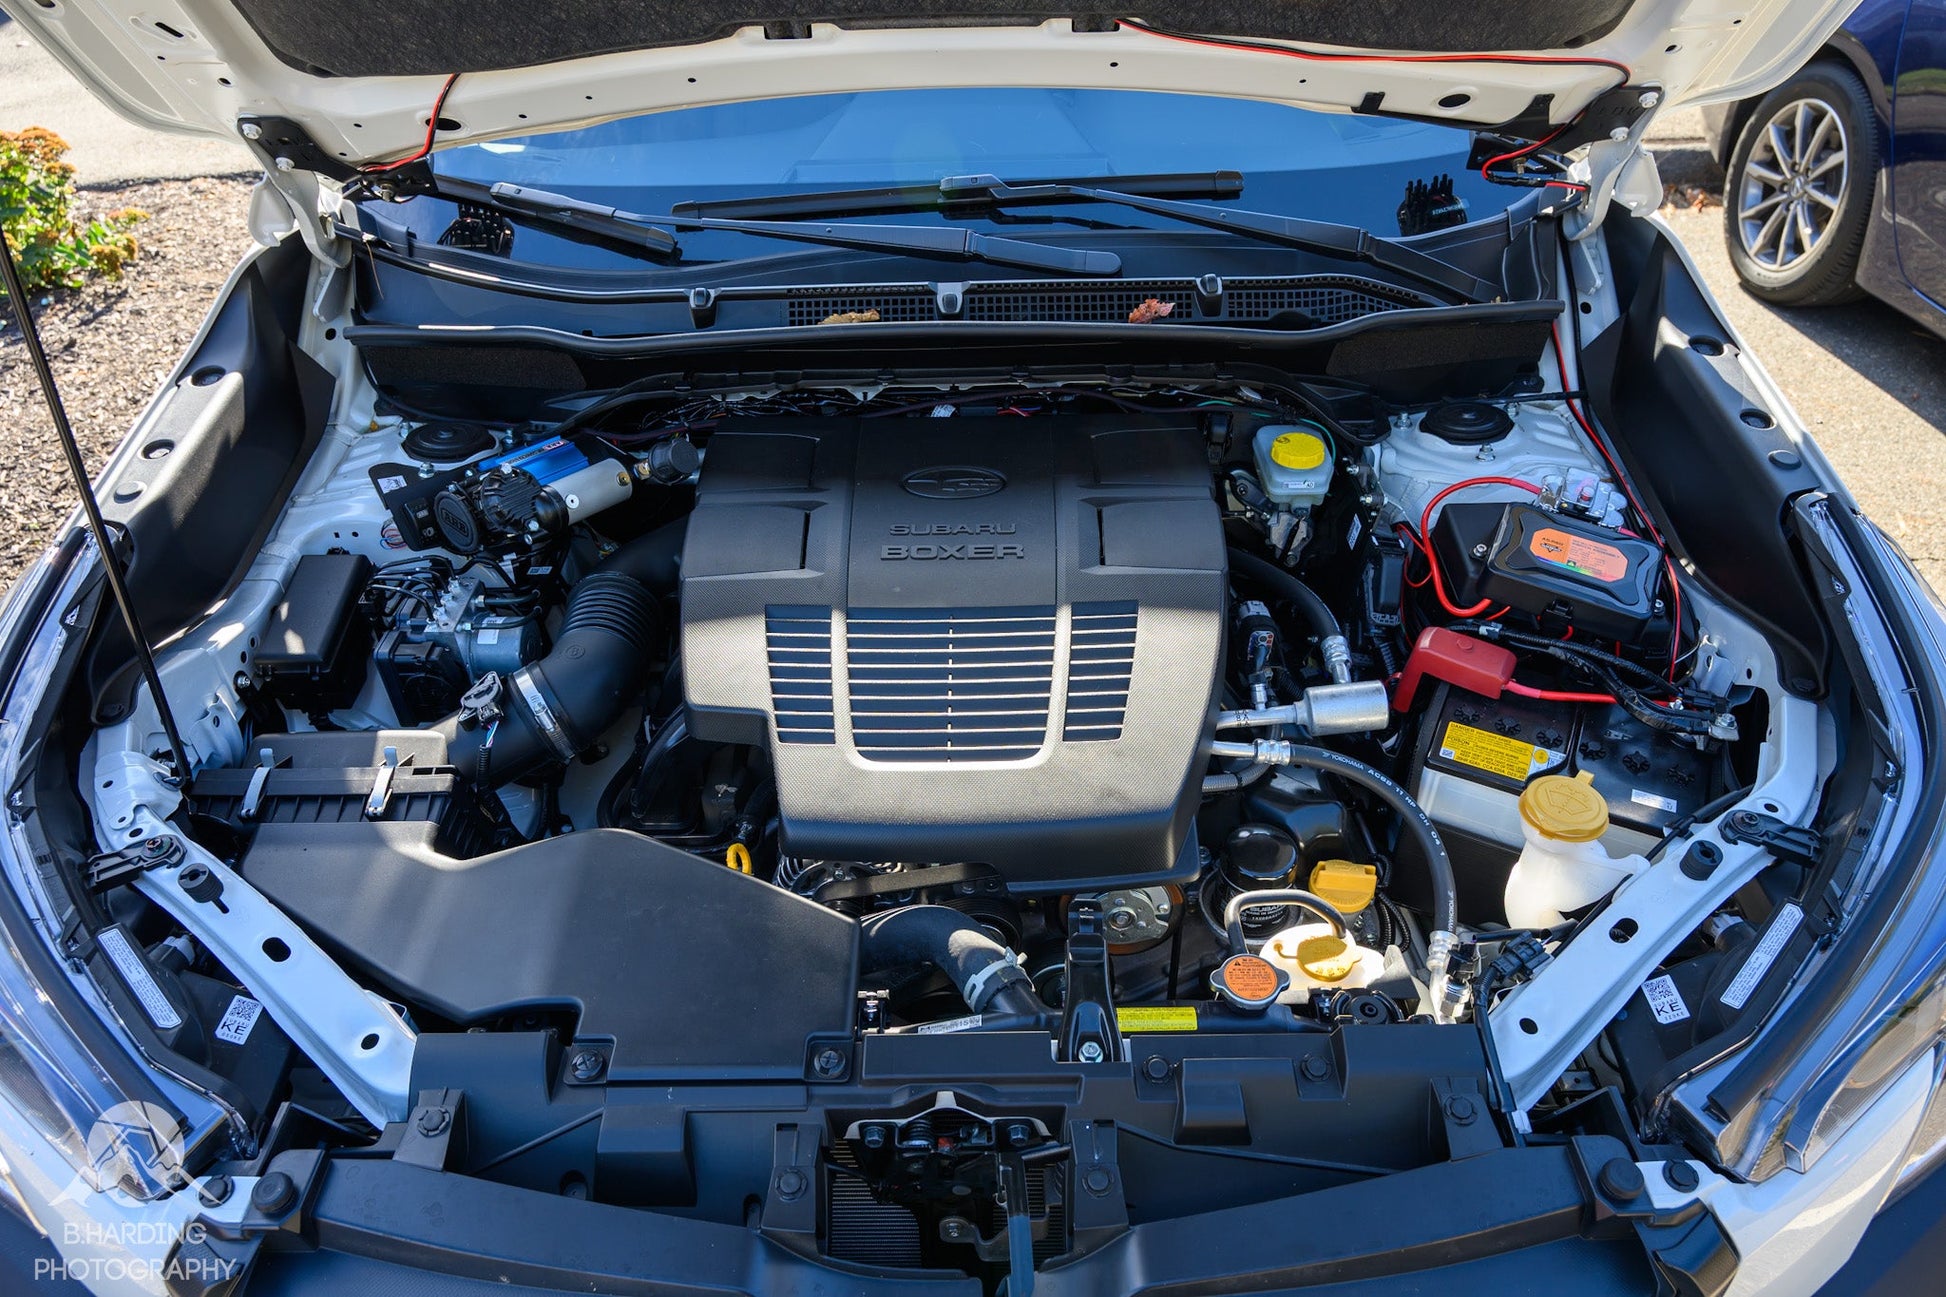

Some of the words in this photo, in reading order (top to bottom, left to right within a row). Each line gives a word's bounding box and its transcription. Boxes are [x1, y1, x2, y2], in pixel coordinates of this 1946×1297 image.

[889, 523, 1017, 536] SUBARU
[881, 544, 1025, 560] BOXER
[1450, 723, 1475, 733] DANGER
[1446, 736, 1470, 746] POISON
[1330, 754, 1364, 770] YOKOHAMA
[1405, 796, 1416, 808] HP
[1419, 813, 1430, 826] DH
[1655, 1001, 1682, 1016] KE
[221, 1021, 247, 1036] KE
